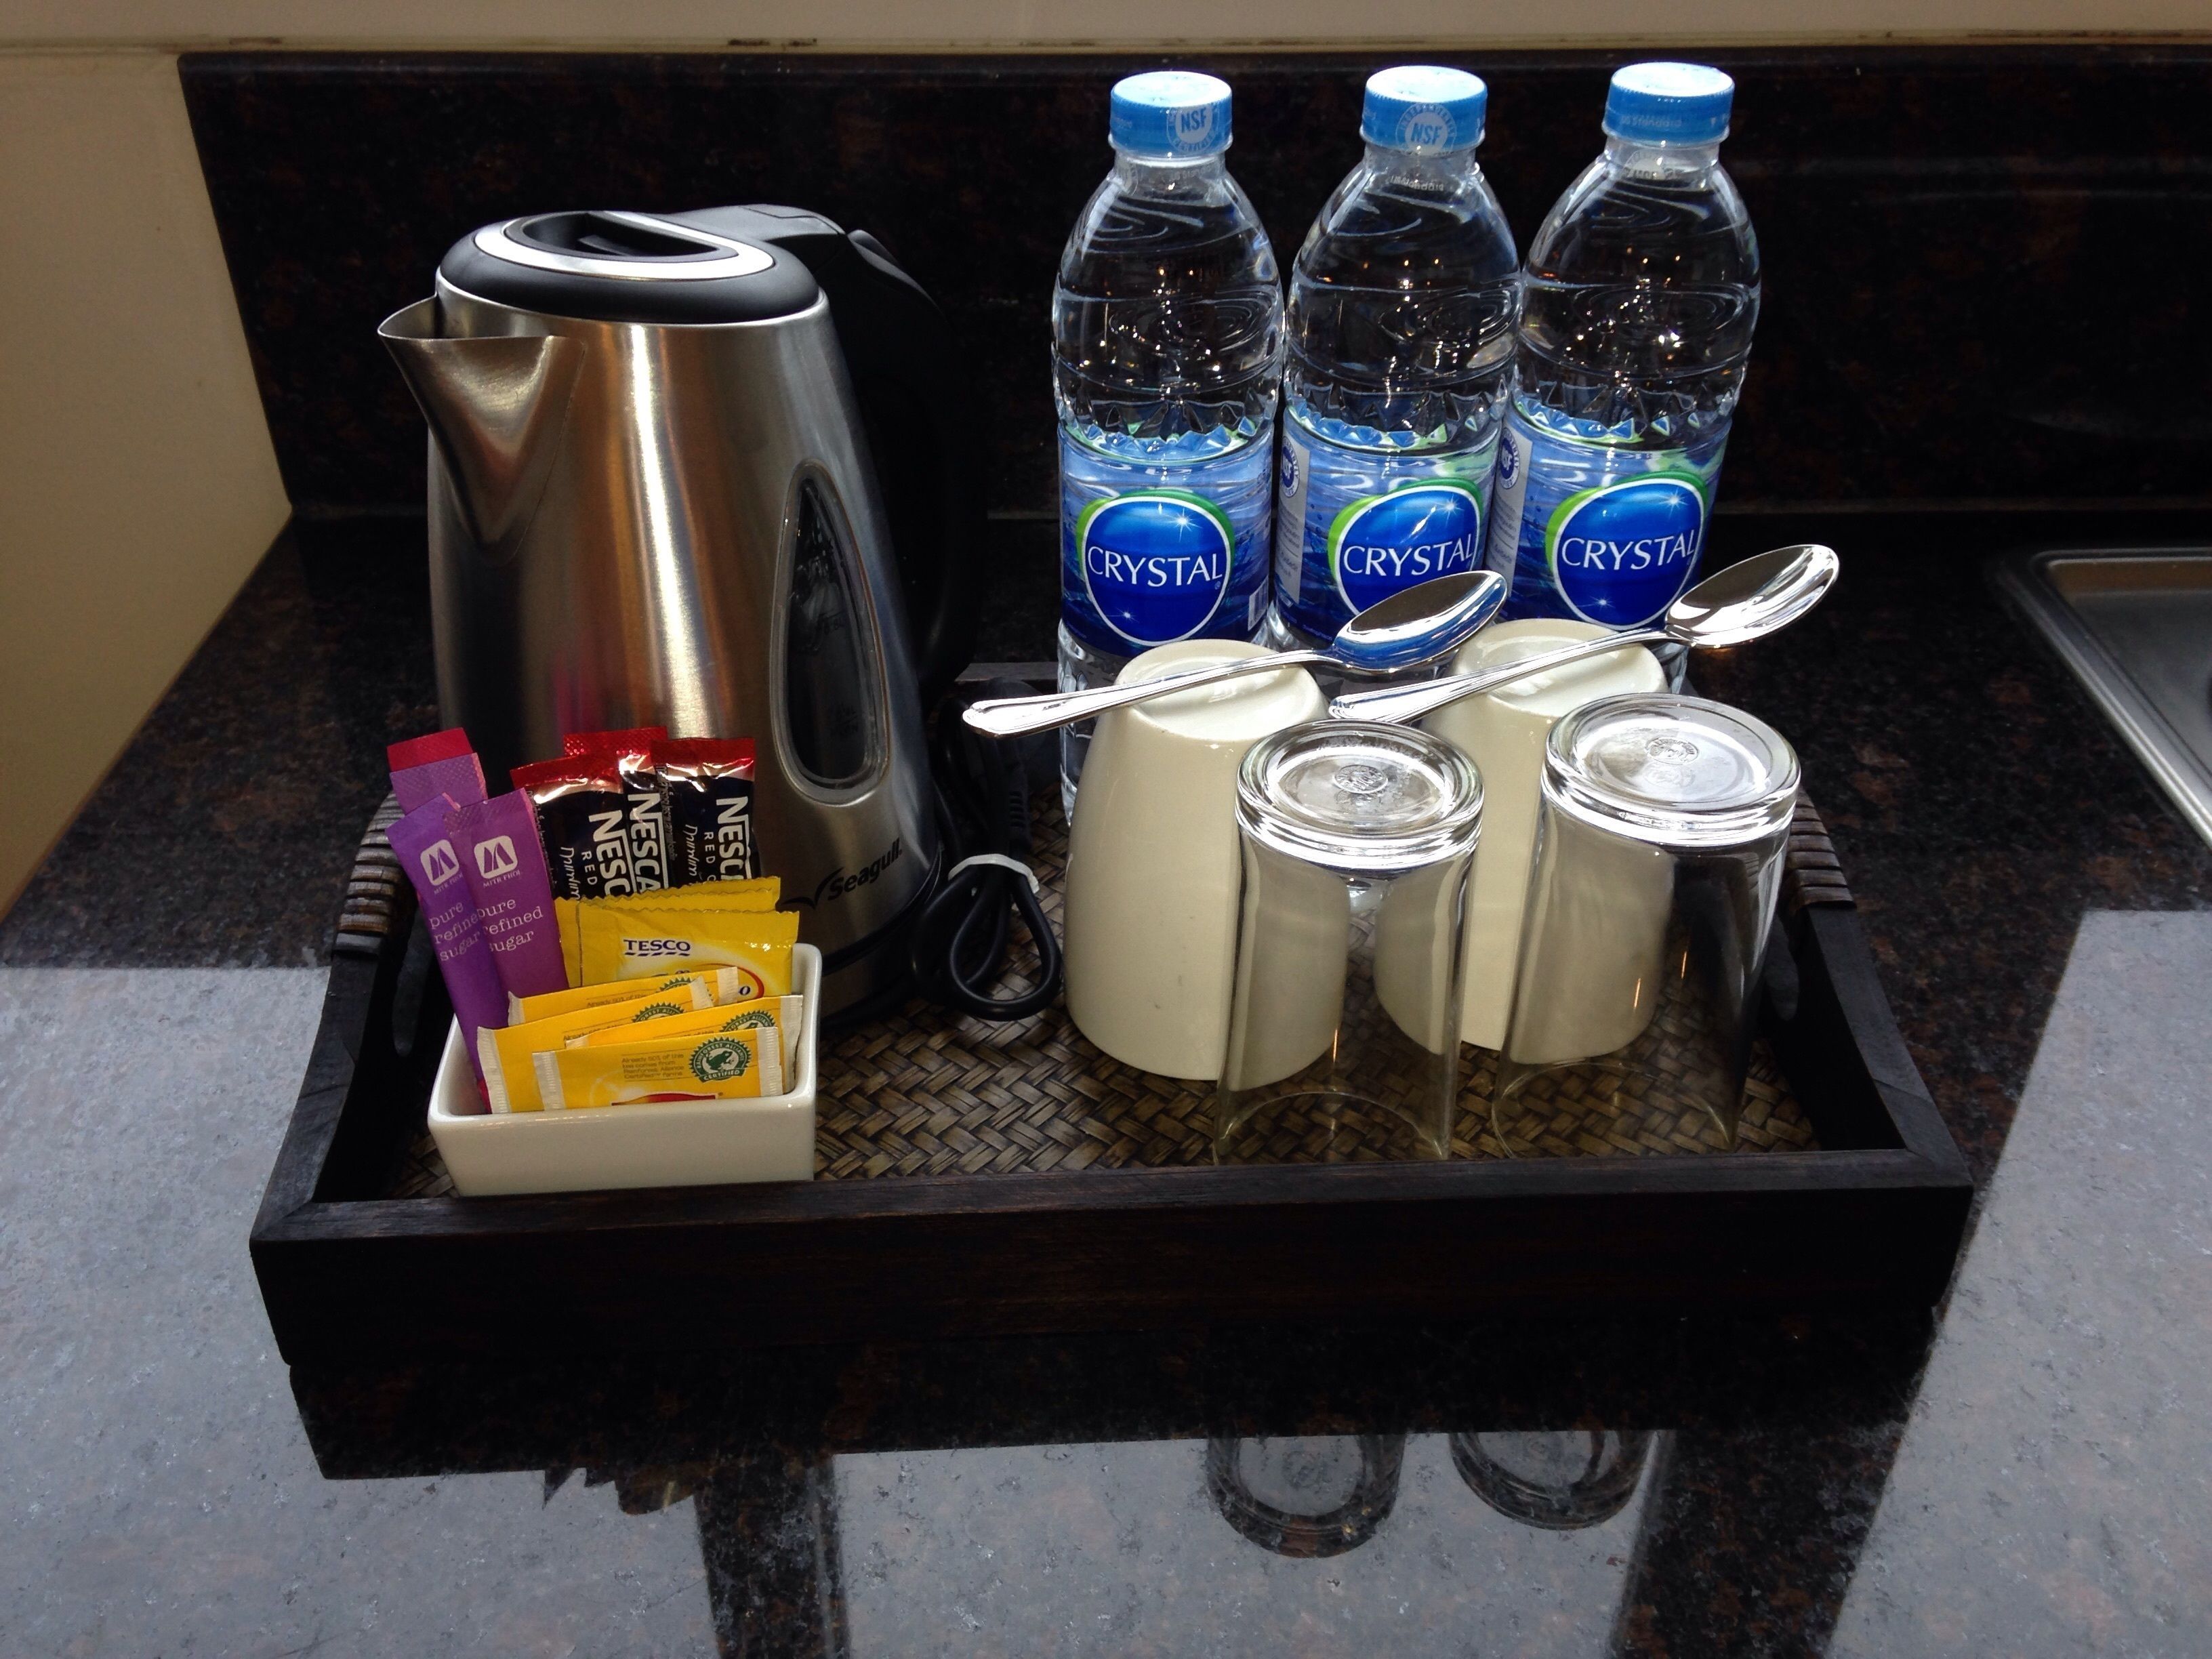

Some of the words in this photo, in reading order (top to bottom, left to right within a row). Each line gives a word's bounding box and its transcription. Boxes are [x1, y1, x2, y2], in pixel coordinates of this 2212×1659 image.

[1181, 107, 1207, 134] NSF
[1411, 123, 1443, 145] NSF
[1343, 533, 1473, 577] CRYSTAL
[1561, 529, 1695, 571] CRYSTAL
[1088, 546, 1223, 587] CRYSTAL
[703, 831, 716, 864] RED
[581, 851, 598, 885] RED
[827, 838, 901, 901] Seagull
[429, 902, 464, 930] pure
[434, 913, 478, 945] refine
[440, 931, 480, 962] sugar
[490, 930, 534, 952] ugar
[623, 939, 691, 951] TESCO
[703, 1069, 740, 1080] CERTIFIED
